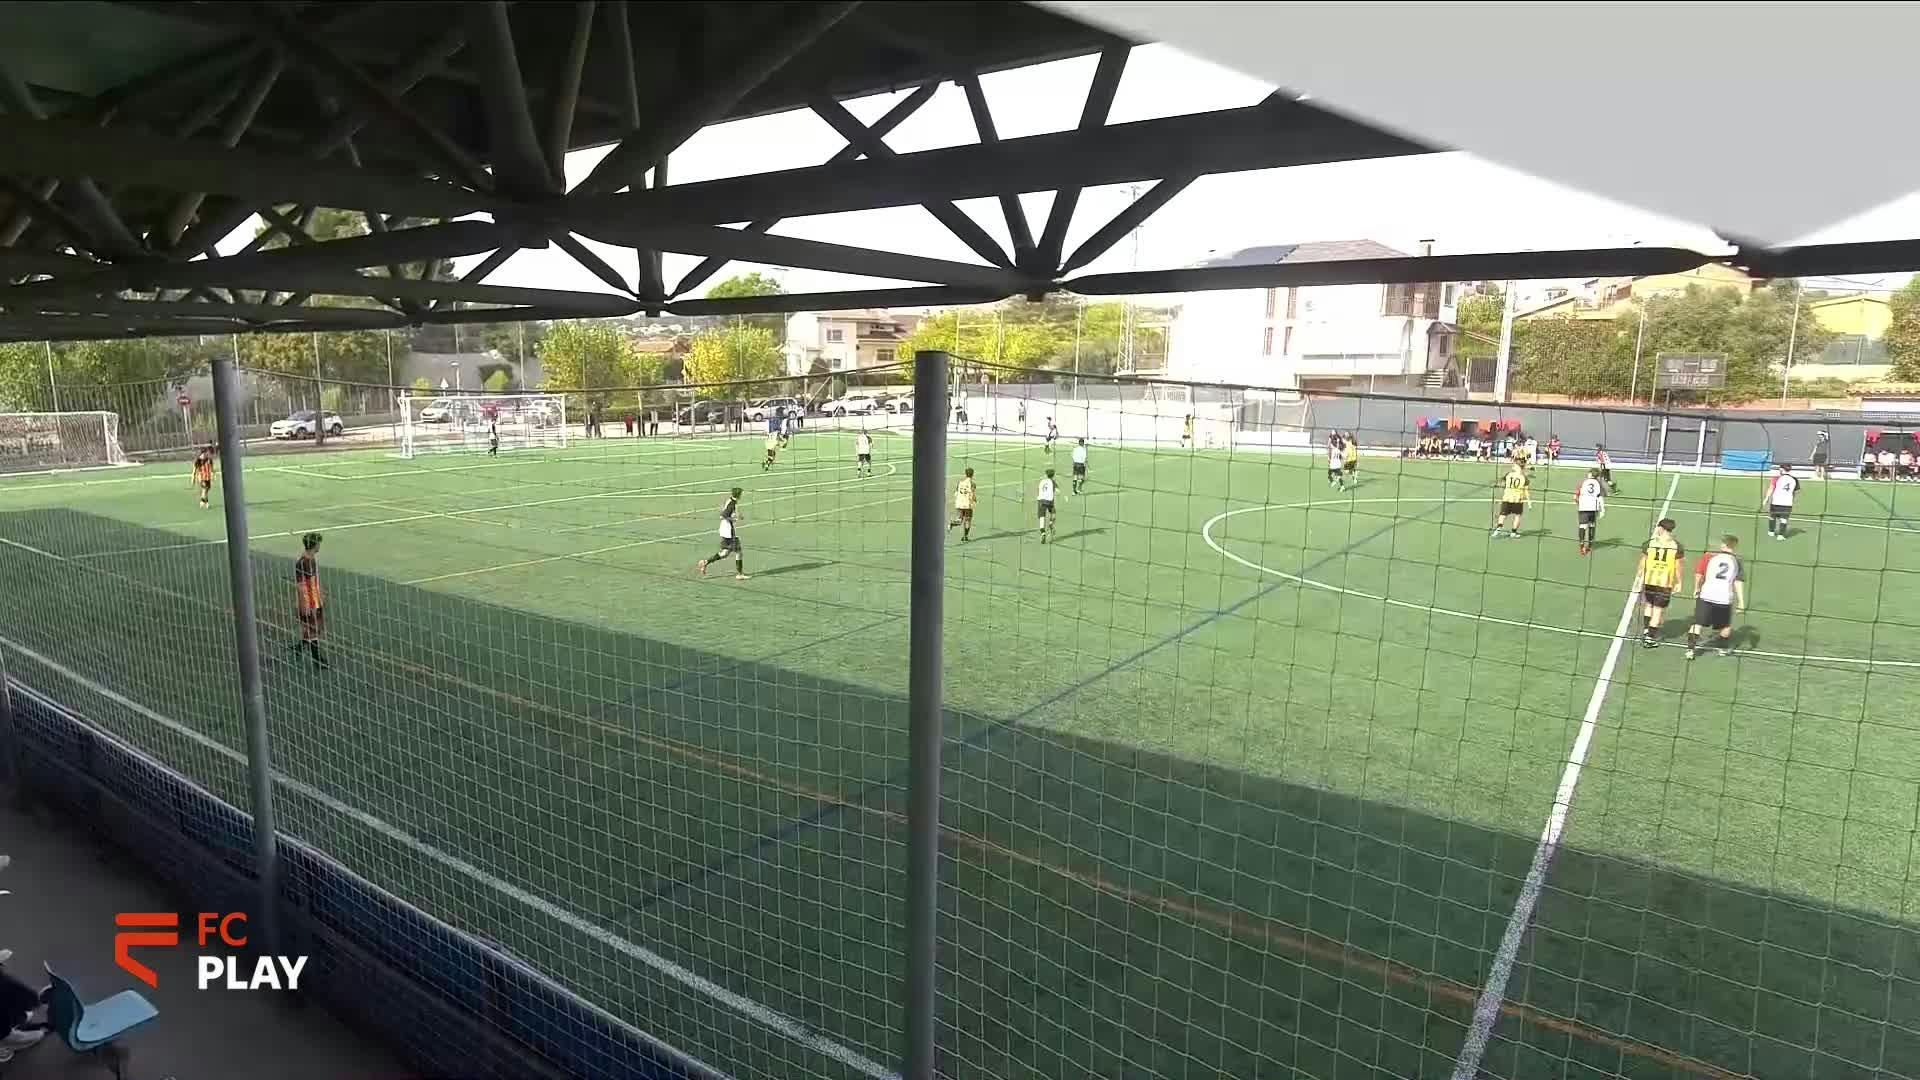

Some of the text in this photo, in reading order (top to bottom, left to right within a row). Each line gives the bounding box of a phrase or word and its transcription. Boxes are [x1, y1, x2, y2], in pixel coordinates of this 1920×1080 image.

[1509, 477, 1521, 489] 10
[1587, 483, 1595, 494] 3
[1782, 482, 1791, 492] 4
[1654, 546, 1668, 562] 11
[1715, 561, 1729, 580] 2
